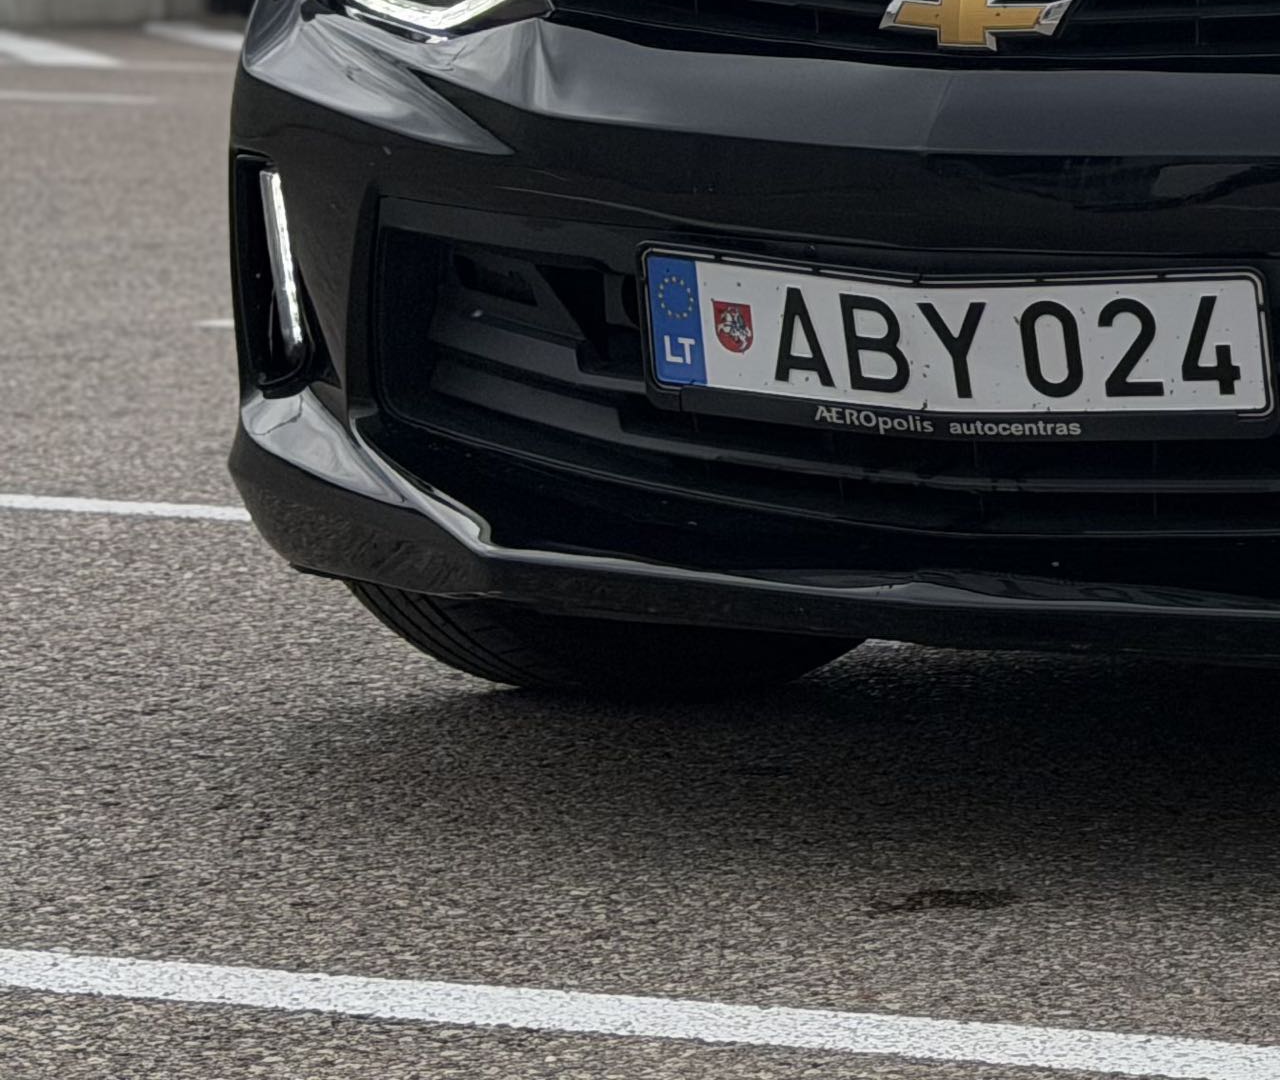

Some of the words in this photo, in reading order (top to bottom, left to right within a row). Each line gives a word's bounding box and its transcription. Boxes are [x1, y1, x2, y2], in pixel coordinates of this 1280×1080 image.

[664, 335, 696, 364] LT
[774, 286, 986, 398] ABY
[1020, 296, 1241, 398] 024
[814, 405, 934, 435] AEROpolis
[949, 421, 1082, 436] autocentras
